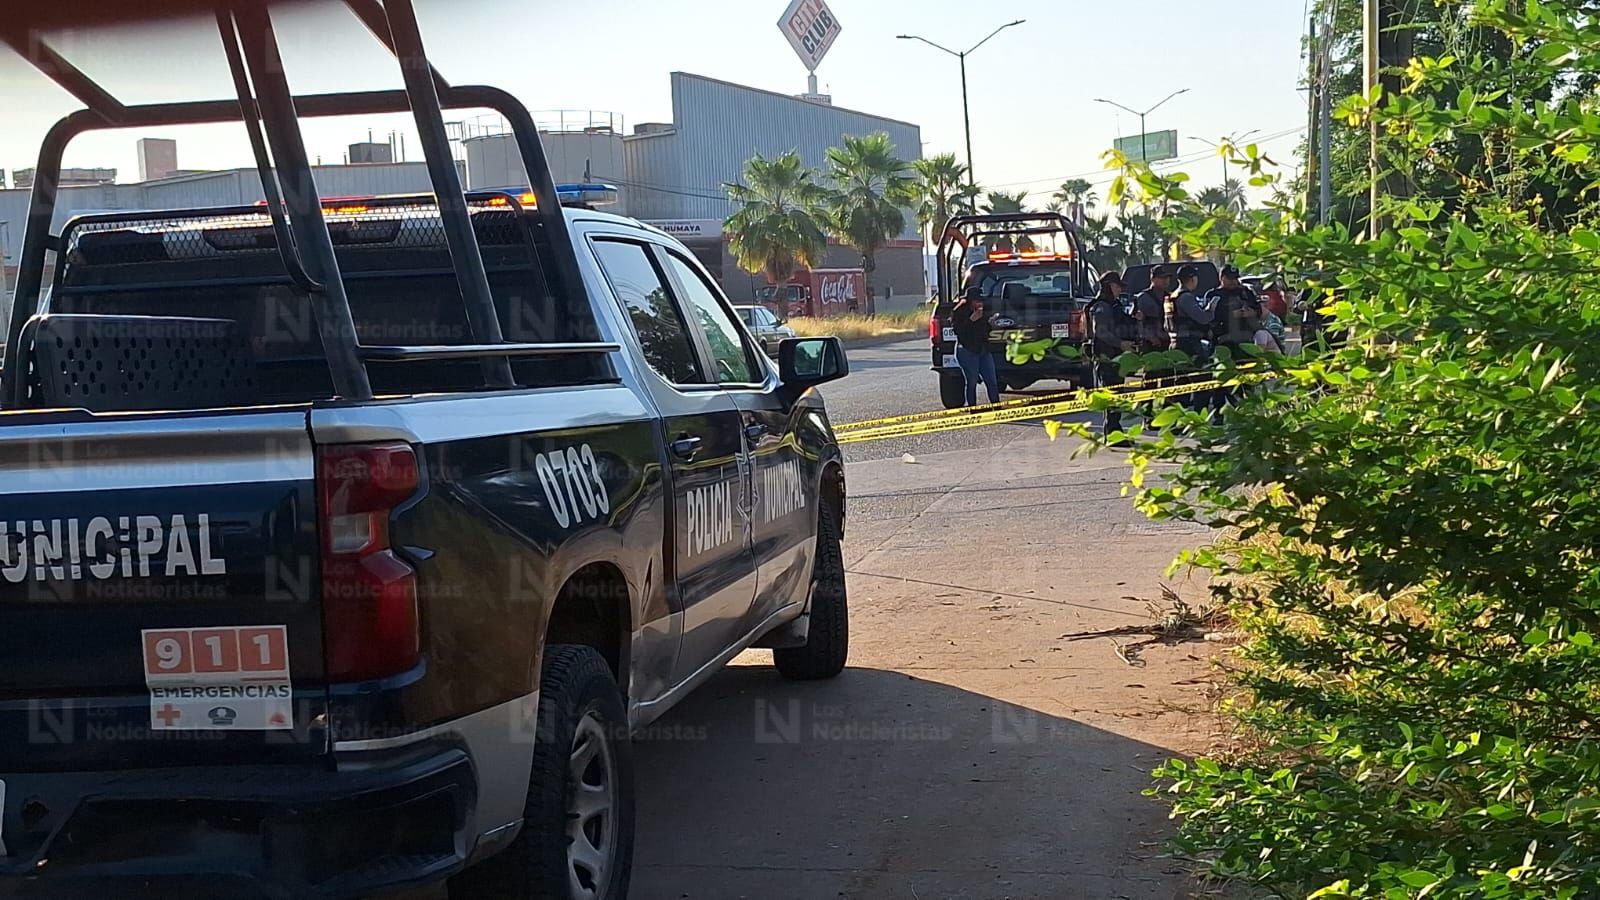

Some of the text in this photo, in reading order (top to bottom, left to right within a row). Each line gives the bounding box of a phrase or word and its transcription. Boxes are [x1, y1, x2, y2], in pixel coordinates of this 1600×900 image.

[802, 9, 833, 55] CLUB
[535, 443, 609, 529] 0703
[763, 457, 806, 525] MUNICIPAL
[152, 684, 290, 698] EMERGENCIAS
